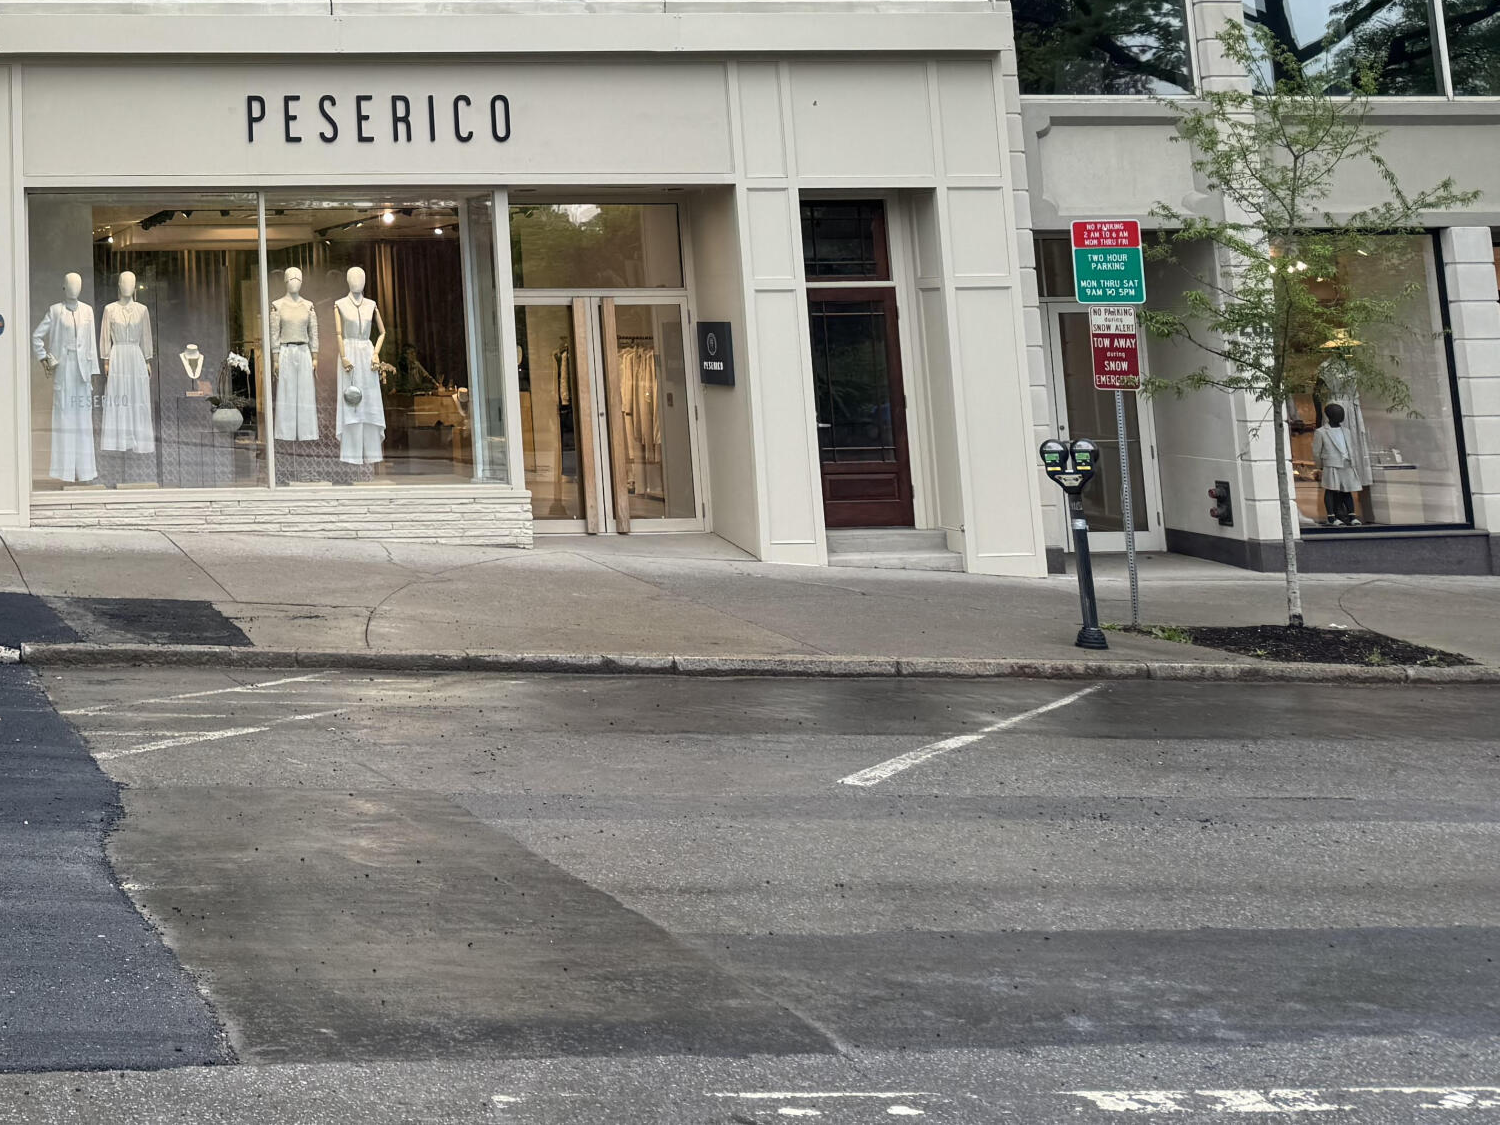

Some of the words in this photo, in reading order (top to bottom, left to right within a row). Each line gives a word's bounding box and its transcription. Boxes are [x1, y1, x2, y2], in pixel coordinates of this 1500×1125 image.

[247, 94, 511, 143] PESERICO
[1088, 254, 1104, 262] TWO
[1091, 262, 1125, 270] PARKING
[1119, 288, 1135, 296] 5PM
[1092, 308, 1102, 316] NO
[1104, 308, 1133, 316] PARKING
[1093, 324, 1111, 332] SNOW
[1115, 324, 1134, 332] ALERT
[1093, 338, 1110, 348] TOW
[1114, 338, 1136, 348] AWAY
[1104, 360, 1128, 371] SNOW
[70, 394, 129, 408] PESERICO
